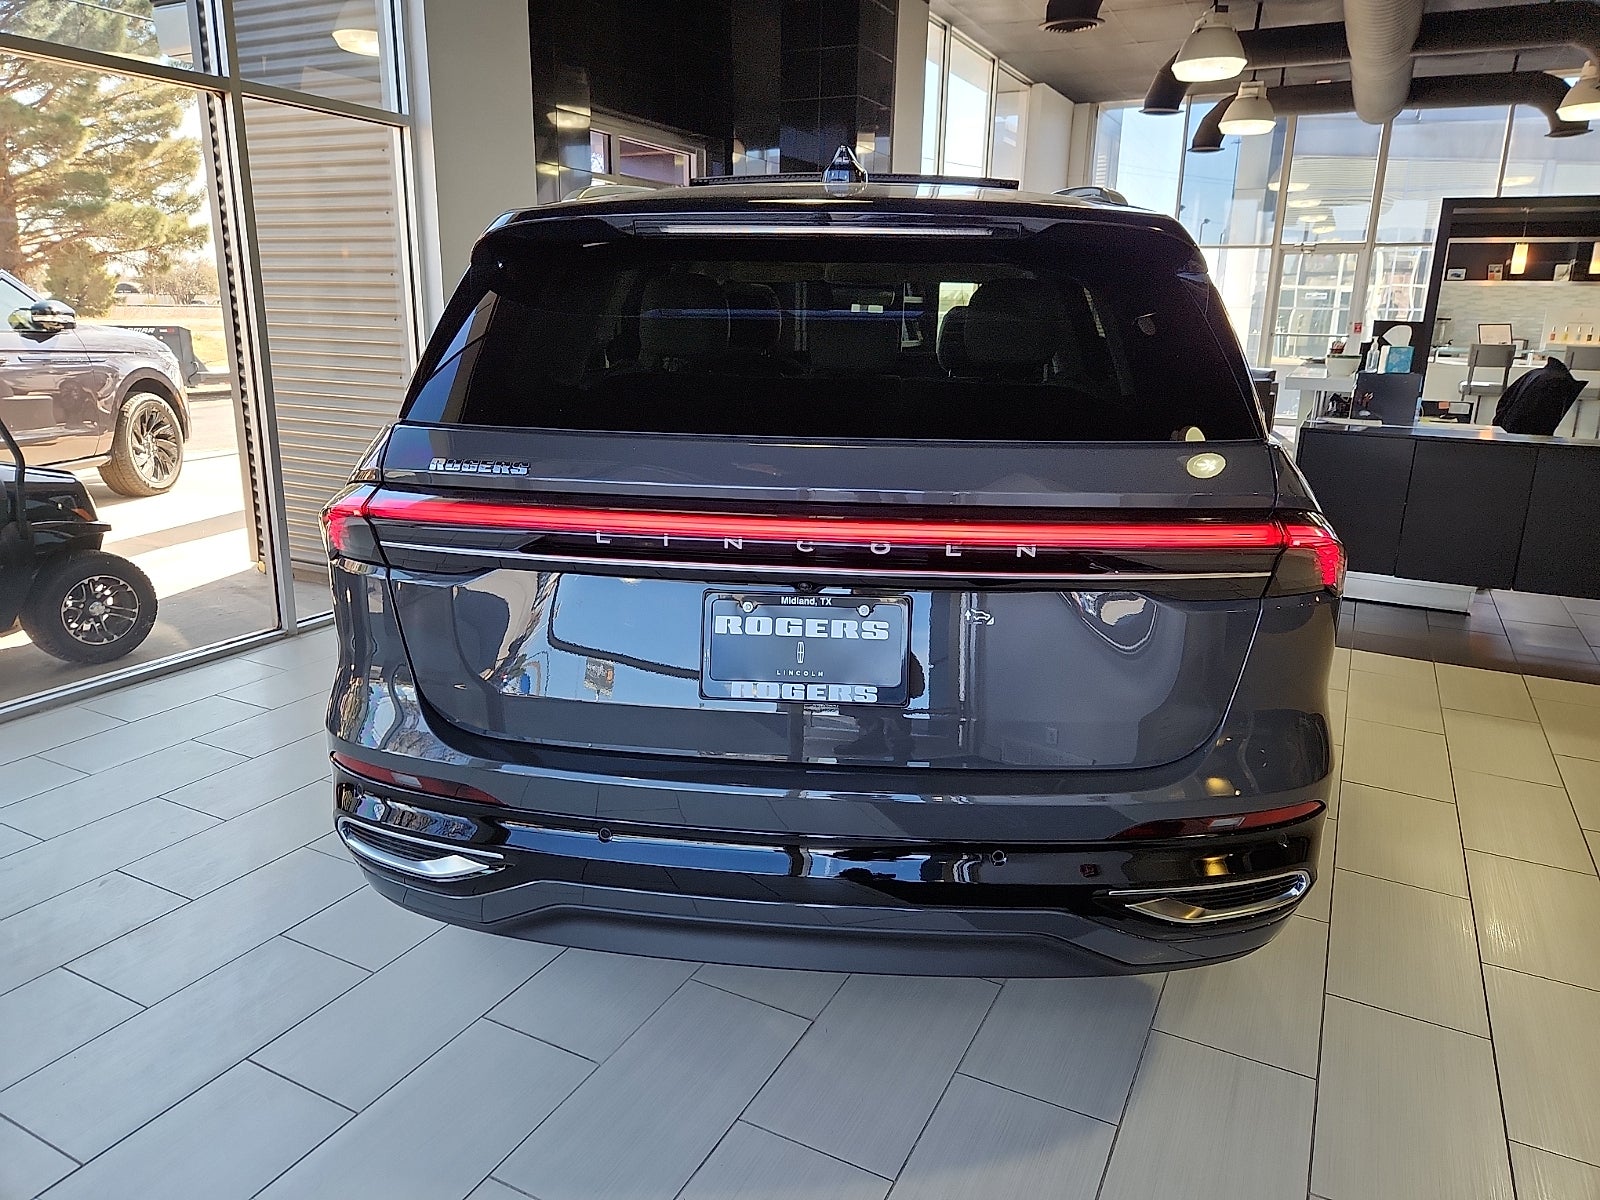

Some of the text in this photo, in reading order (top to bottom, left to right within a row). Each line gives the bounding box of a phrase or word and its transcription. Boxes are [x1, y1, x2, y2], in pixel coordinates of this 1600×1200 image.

[428, 457, 530, 475] ROGERS
[596, 530, 1037, 558] LINCOLN
[780, 597, 832, 606] Midland, TX
[714, 615, 889, 640] ROGERS
[776, 669, 824, 677] LINCOLN
[731, 682, 878, 703] ROGERS
